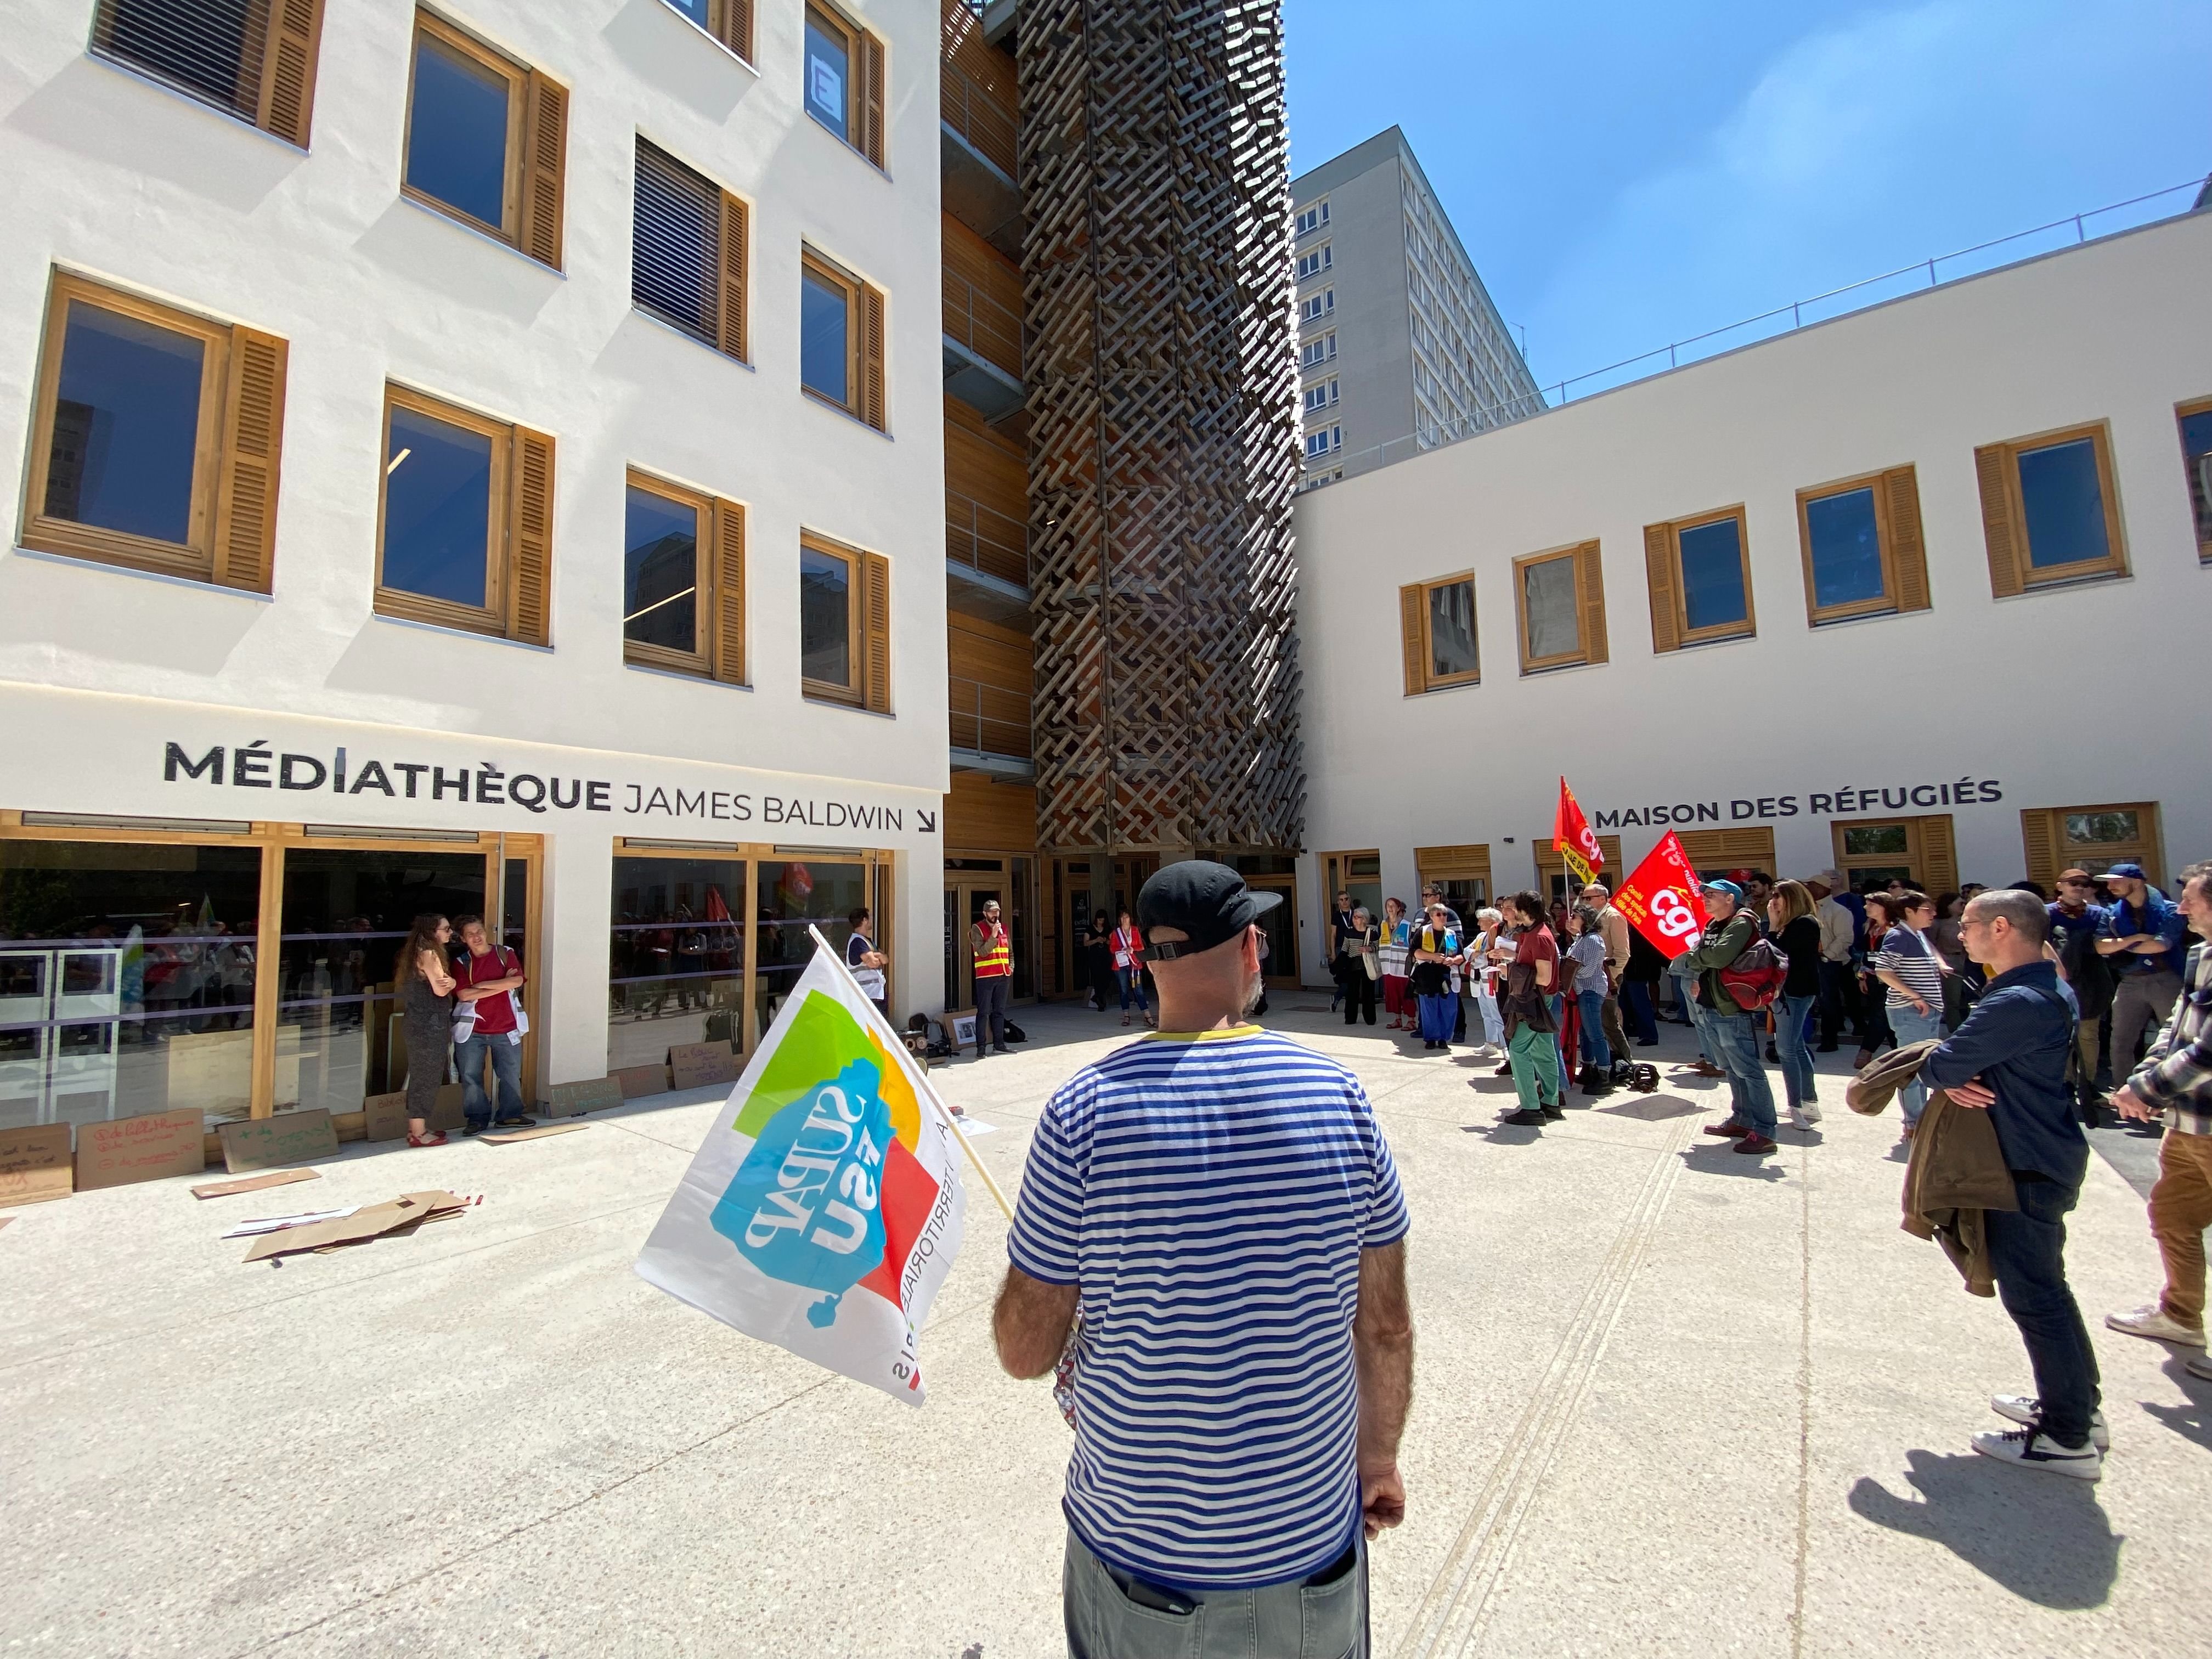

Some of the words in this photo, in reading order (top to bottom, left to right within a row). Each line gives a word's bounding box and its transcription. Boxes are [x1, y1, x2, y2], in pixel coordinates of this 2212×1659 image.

[814, 65, 834, 112] E
[163, 740, 611, 813] MÉDIATHÈQUE
[624, 785, 752, 821] JAMES
[764, 797, 902, 831] BALDWIN
[1595, 802, 1719, 829] MAISON
[1731, 795, 1799, 820] DES
[1809, 776, 2003, 814] RÉFUGIÉS
